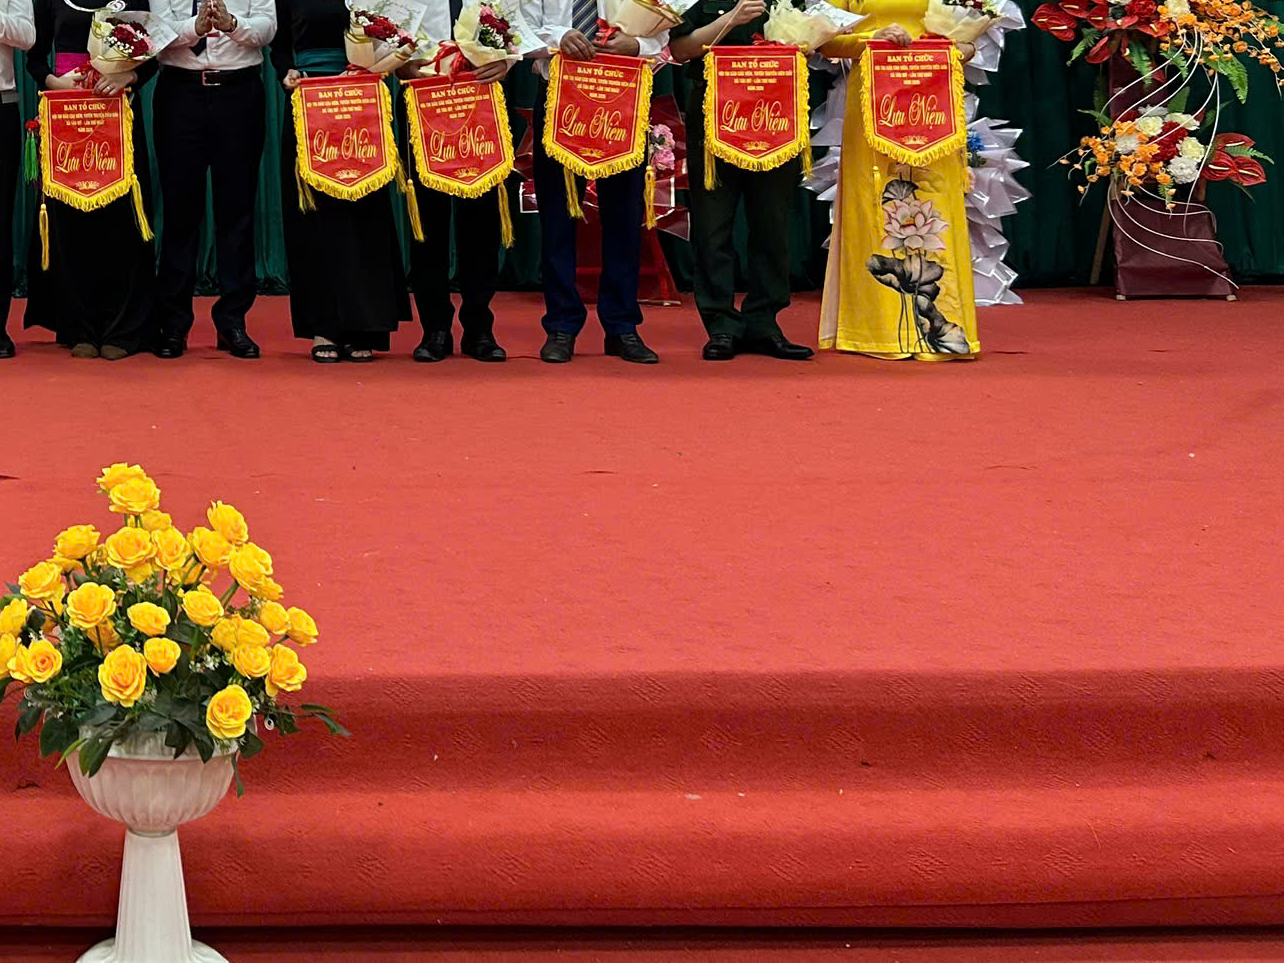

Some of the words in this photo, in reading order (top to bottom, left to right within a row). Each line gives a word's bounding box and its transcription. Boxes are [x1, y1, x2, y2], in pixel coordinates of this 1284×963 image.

[559, 104, 586, 137] Lưu
[589, 107, 627, 144] Niệm
[720, 100, 748, 133] Lưu
[751, 99, 789, 135] Niệm
[878, 94, 905, 127] Lưu
[909, 93, 946, 129] Niệm
[56, 142, 79, 173] Lưu
[83, 140, 116, 175] Niệm
[313, 130, 337, 162] Lưu
[342, 127, 376, 163] Niệm
[430, 130, 455, 162] Lưu
[458, 125, 495, 160] Niệm
